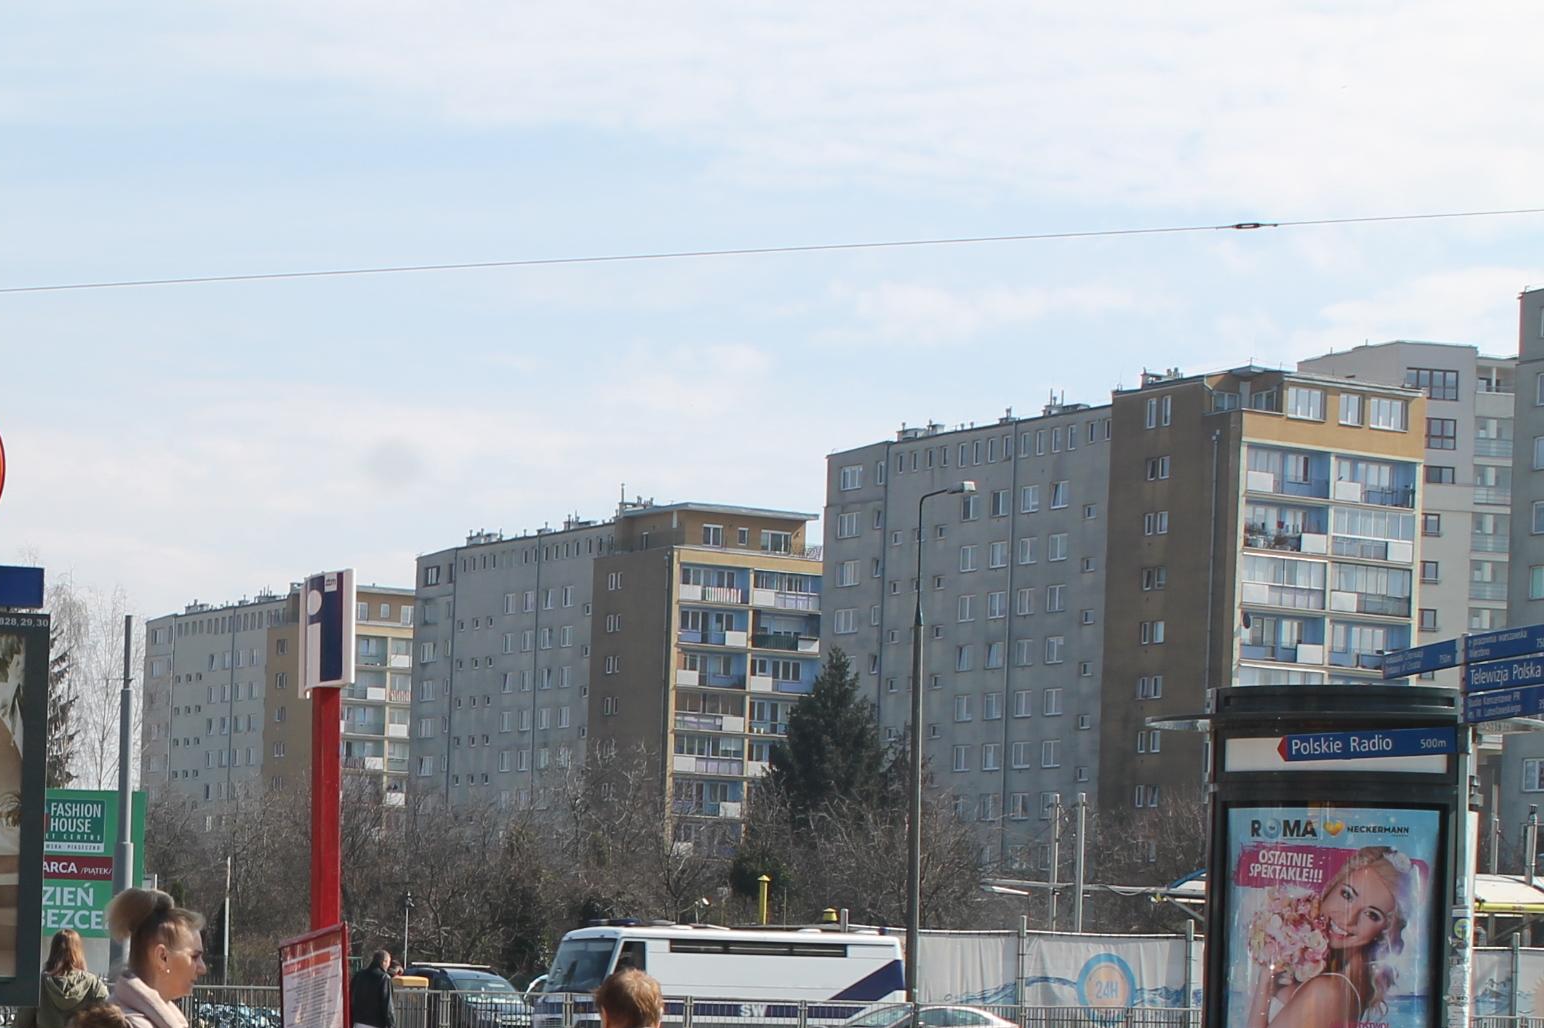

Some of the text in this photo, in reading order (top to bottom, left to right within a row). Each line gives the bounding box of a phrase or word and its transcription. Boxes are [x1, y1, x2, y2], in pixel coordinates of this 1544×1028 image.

[1470, 660, 1542, 687] Telewizja Polska
[1291, 735, 1447, 755] Polskie Radio 500m
[50, 802, 102, 818] FASHION
[50, 818, 92, 833] HOUSE
[1250, 819, 1318, 839] ROMA
[1346, 825, 1409, 835] NECKERMANN
[43, 861, 78, 873] ARCA
[1258, 850, 1315, 868] OSTATNIE
[1248, 863, 1323, 884] SPEKTAKLE!!!
[42, 882, 94, 906] ZIEŃ
[740, 1003, 767, 1018] SW
